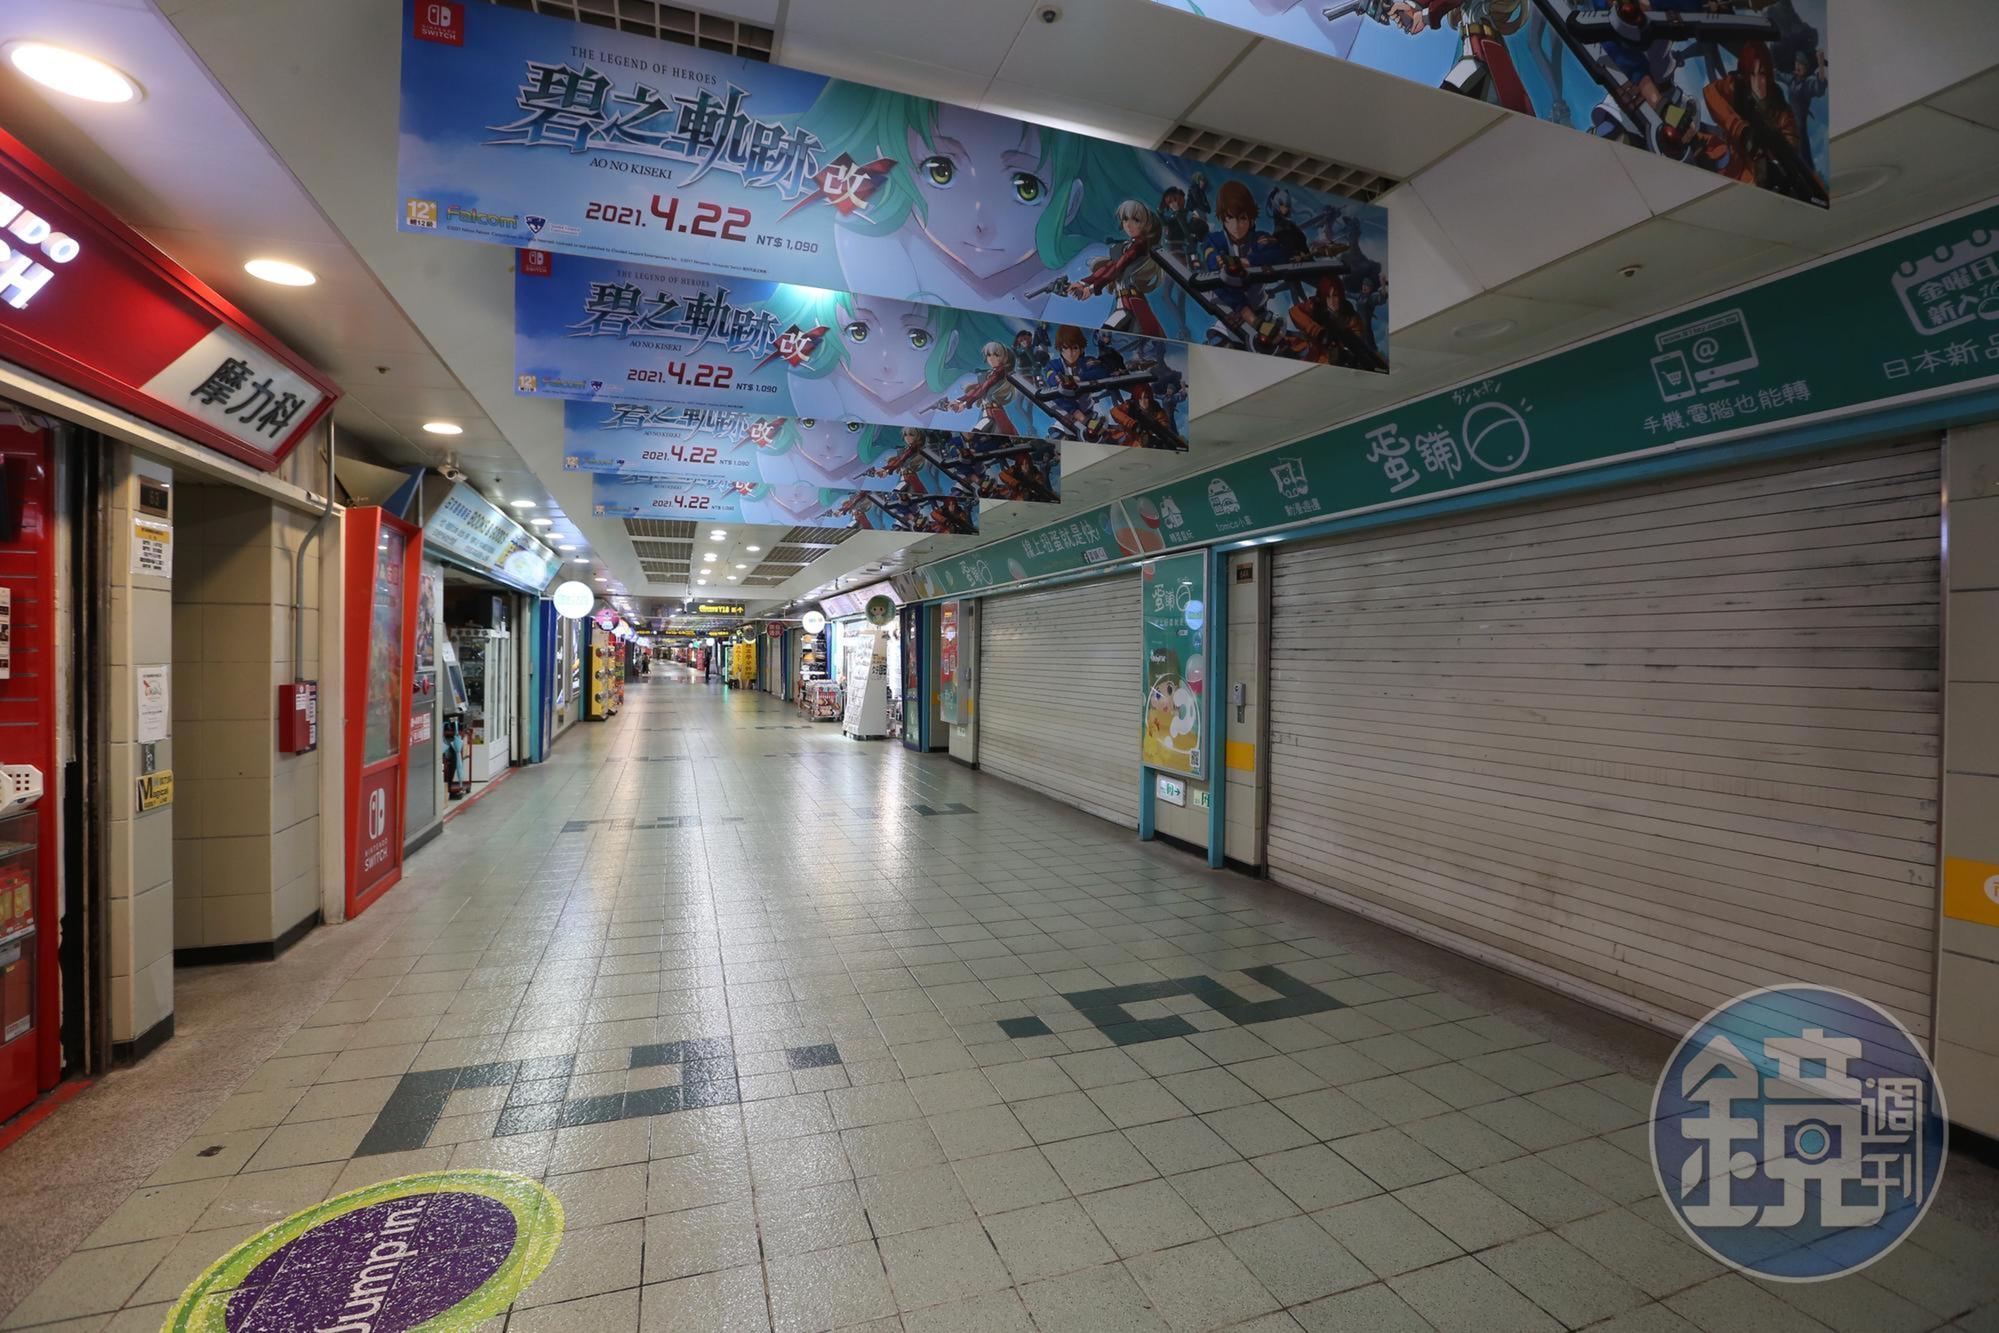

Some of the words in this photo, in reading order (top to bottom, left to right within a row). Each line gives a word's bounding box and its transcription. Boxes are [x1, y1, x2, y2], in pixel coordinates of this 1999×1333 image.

[422, 28, 456, 40] SWITCH
[571, 46, 595, 60] THE
[600, 52, 648, 71] LEGEND
[652, 63, 667, 75] OF
[672, 67, 718, 85] HEROES
[590, 157, 608, 169] AO
[610, 160, 629, 172] NO
[631, 163, 673, 180] KISEKI
[0, 191, 80, 264] DO
[756, 234, 783, 248] NT$
[786, 239, 819, 253] 1,090
[617, 269, 632, 279] THE
[634, 271, 666, 283] LEGEND
[668, 275, 679, 284] OF
[680, 277, 710, 288] HEROES
[655, 342, 683, 352] KISEKI
[736, 382, 754, 391] NT$
[190, 356, 307, 439] 摩力科
[364, 846, 389, 872] SWITCH
